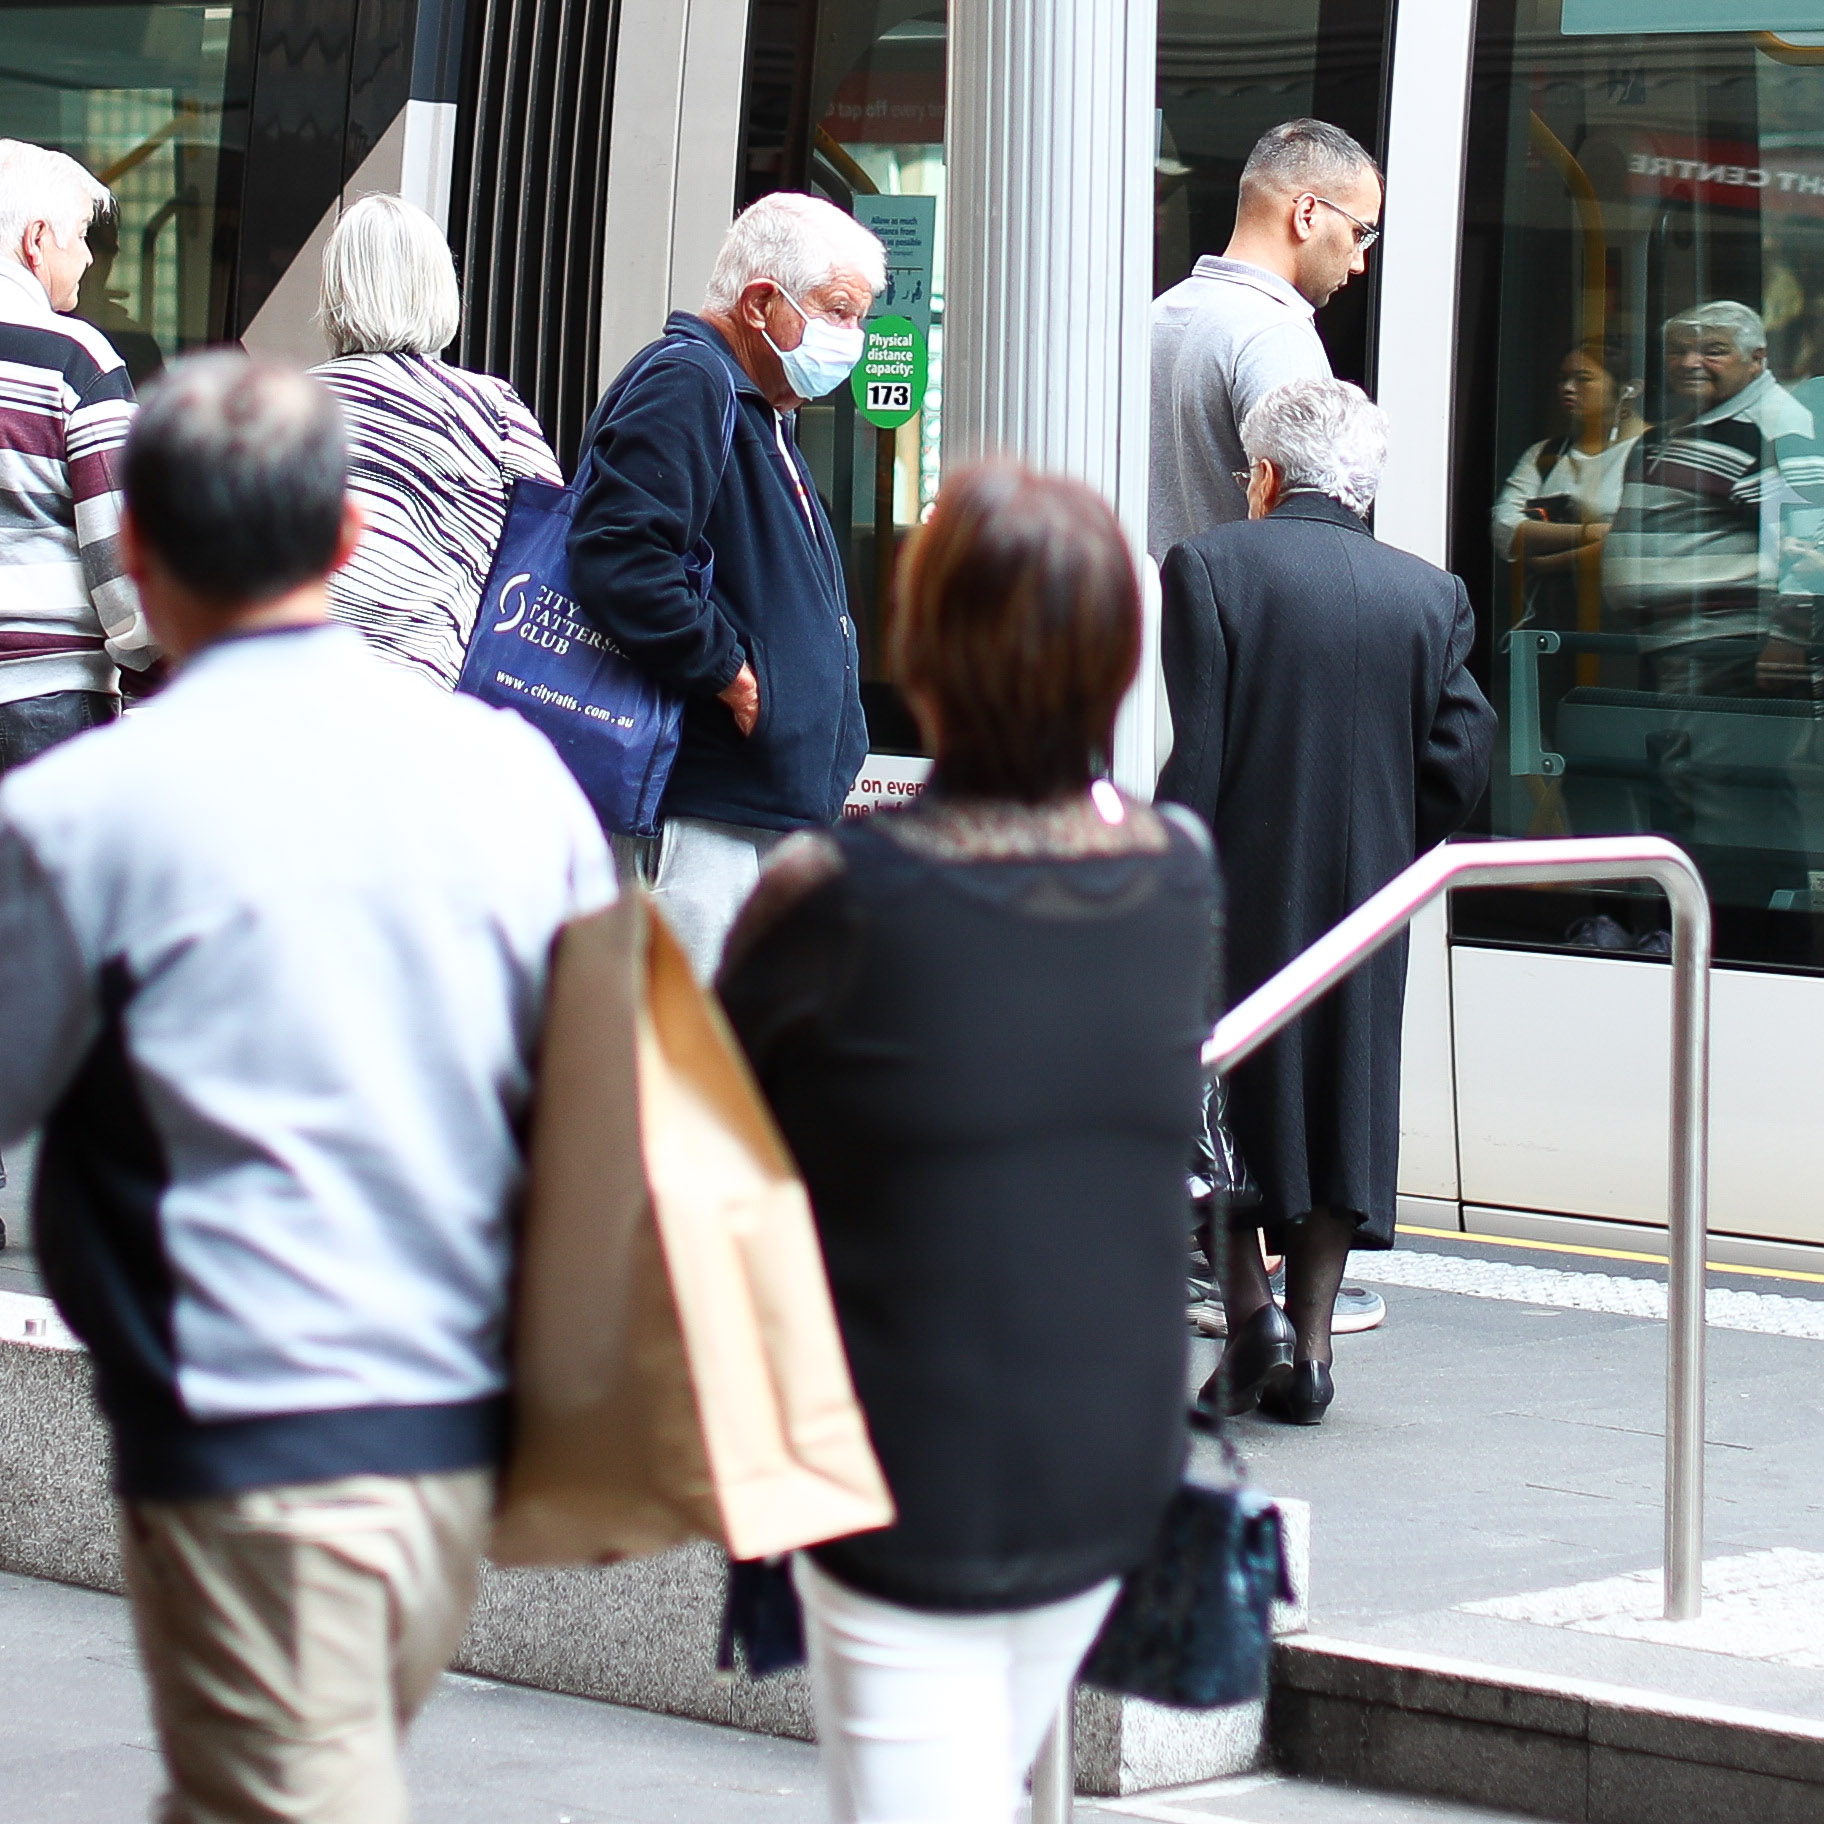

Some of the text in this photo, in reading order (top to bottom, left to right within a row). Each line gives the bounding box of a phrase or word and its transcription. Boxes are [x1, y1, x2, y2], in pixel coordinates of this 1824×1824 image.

[869, 333, 913, 348] Physical
[867, 348, 913, 362] distance
[865, 361, 915, 378] capacity:
[868, 385, 909, 406] 173
[519, 622, 571, 655] CLUB
[861, 779, 882, 794] on
[887, 781, 926, 797] ever
